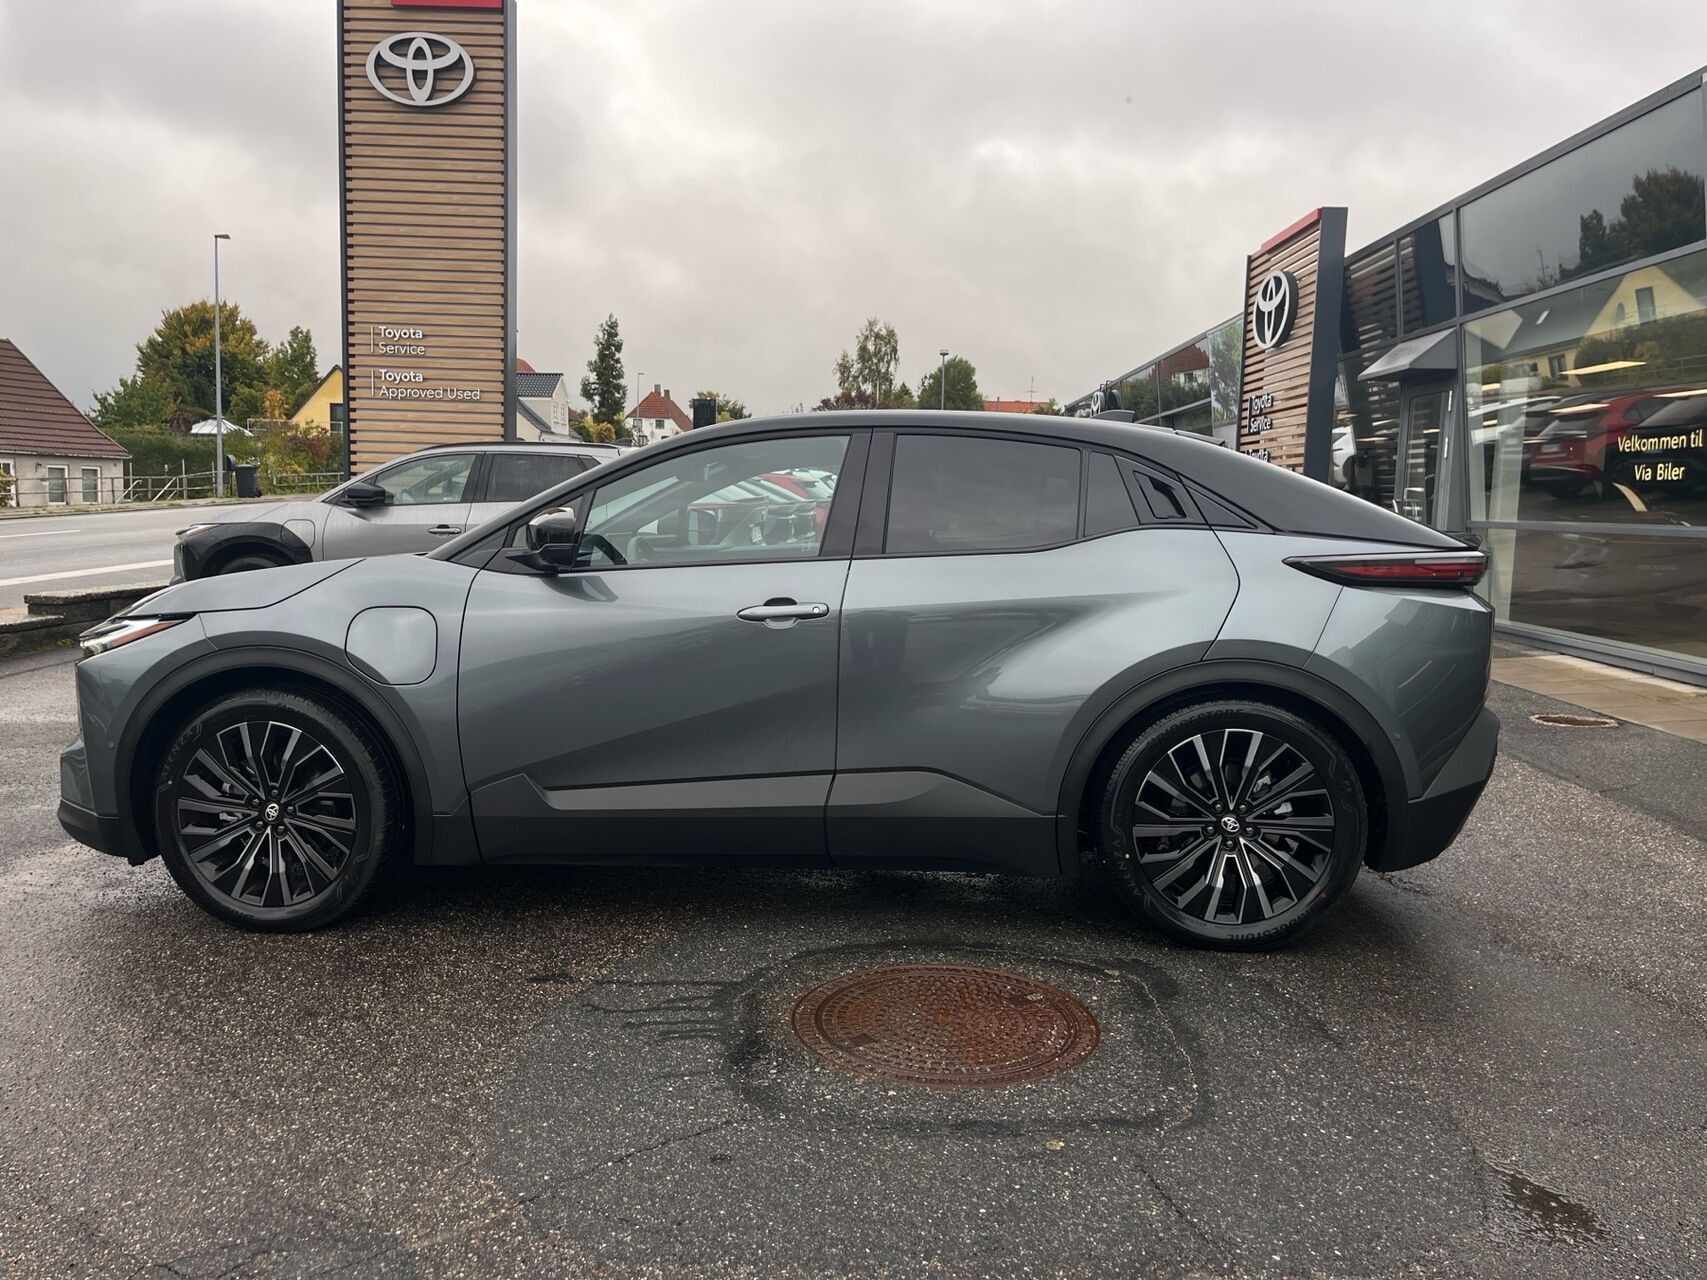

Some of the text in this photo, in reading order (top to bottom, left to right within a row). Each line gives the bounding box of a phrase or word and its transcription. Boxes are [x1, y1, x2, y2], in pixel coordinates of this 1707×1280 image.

[379, 326, 423, 340] Toyota
[379, 342, 425, 355] Service
[379, 369, 423, 384] Toyota
[379, 386, 480, 400] Approved Used
[1252, 394, 1272, 413] Toyota
[1250, 417, 1271, 432] Service
[1618, 429, 1703, 452] Velkommen til
[1634, 462, 1686, 481] Via Biler
